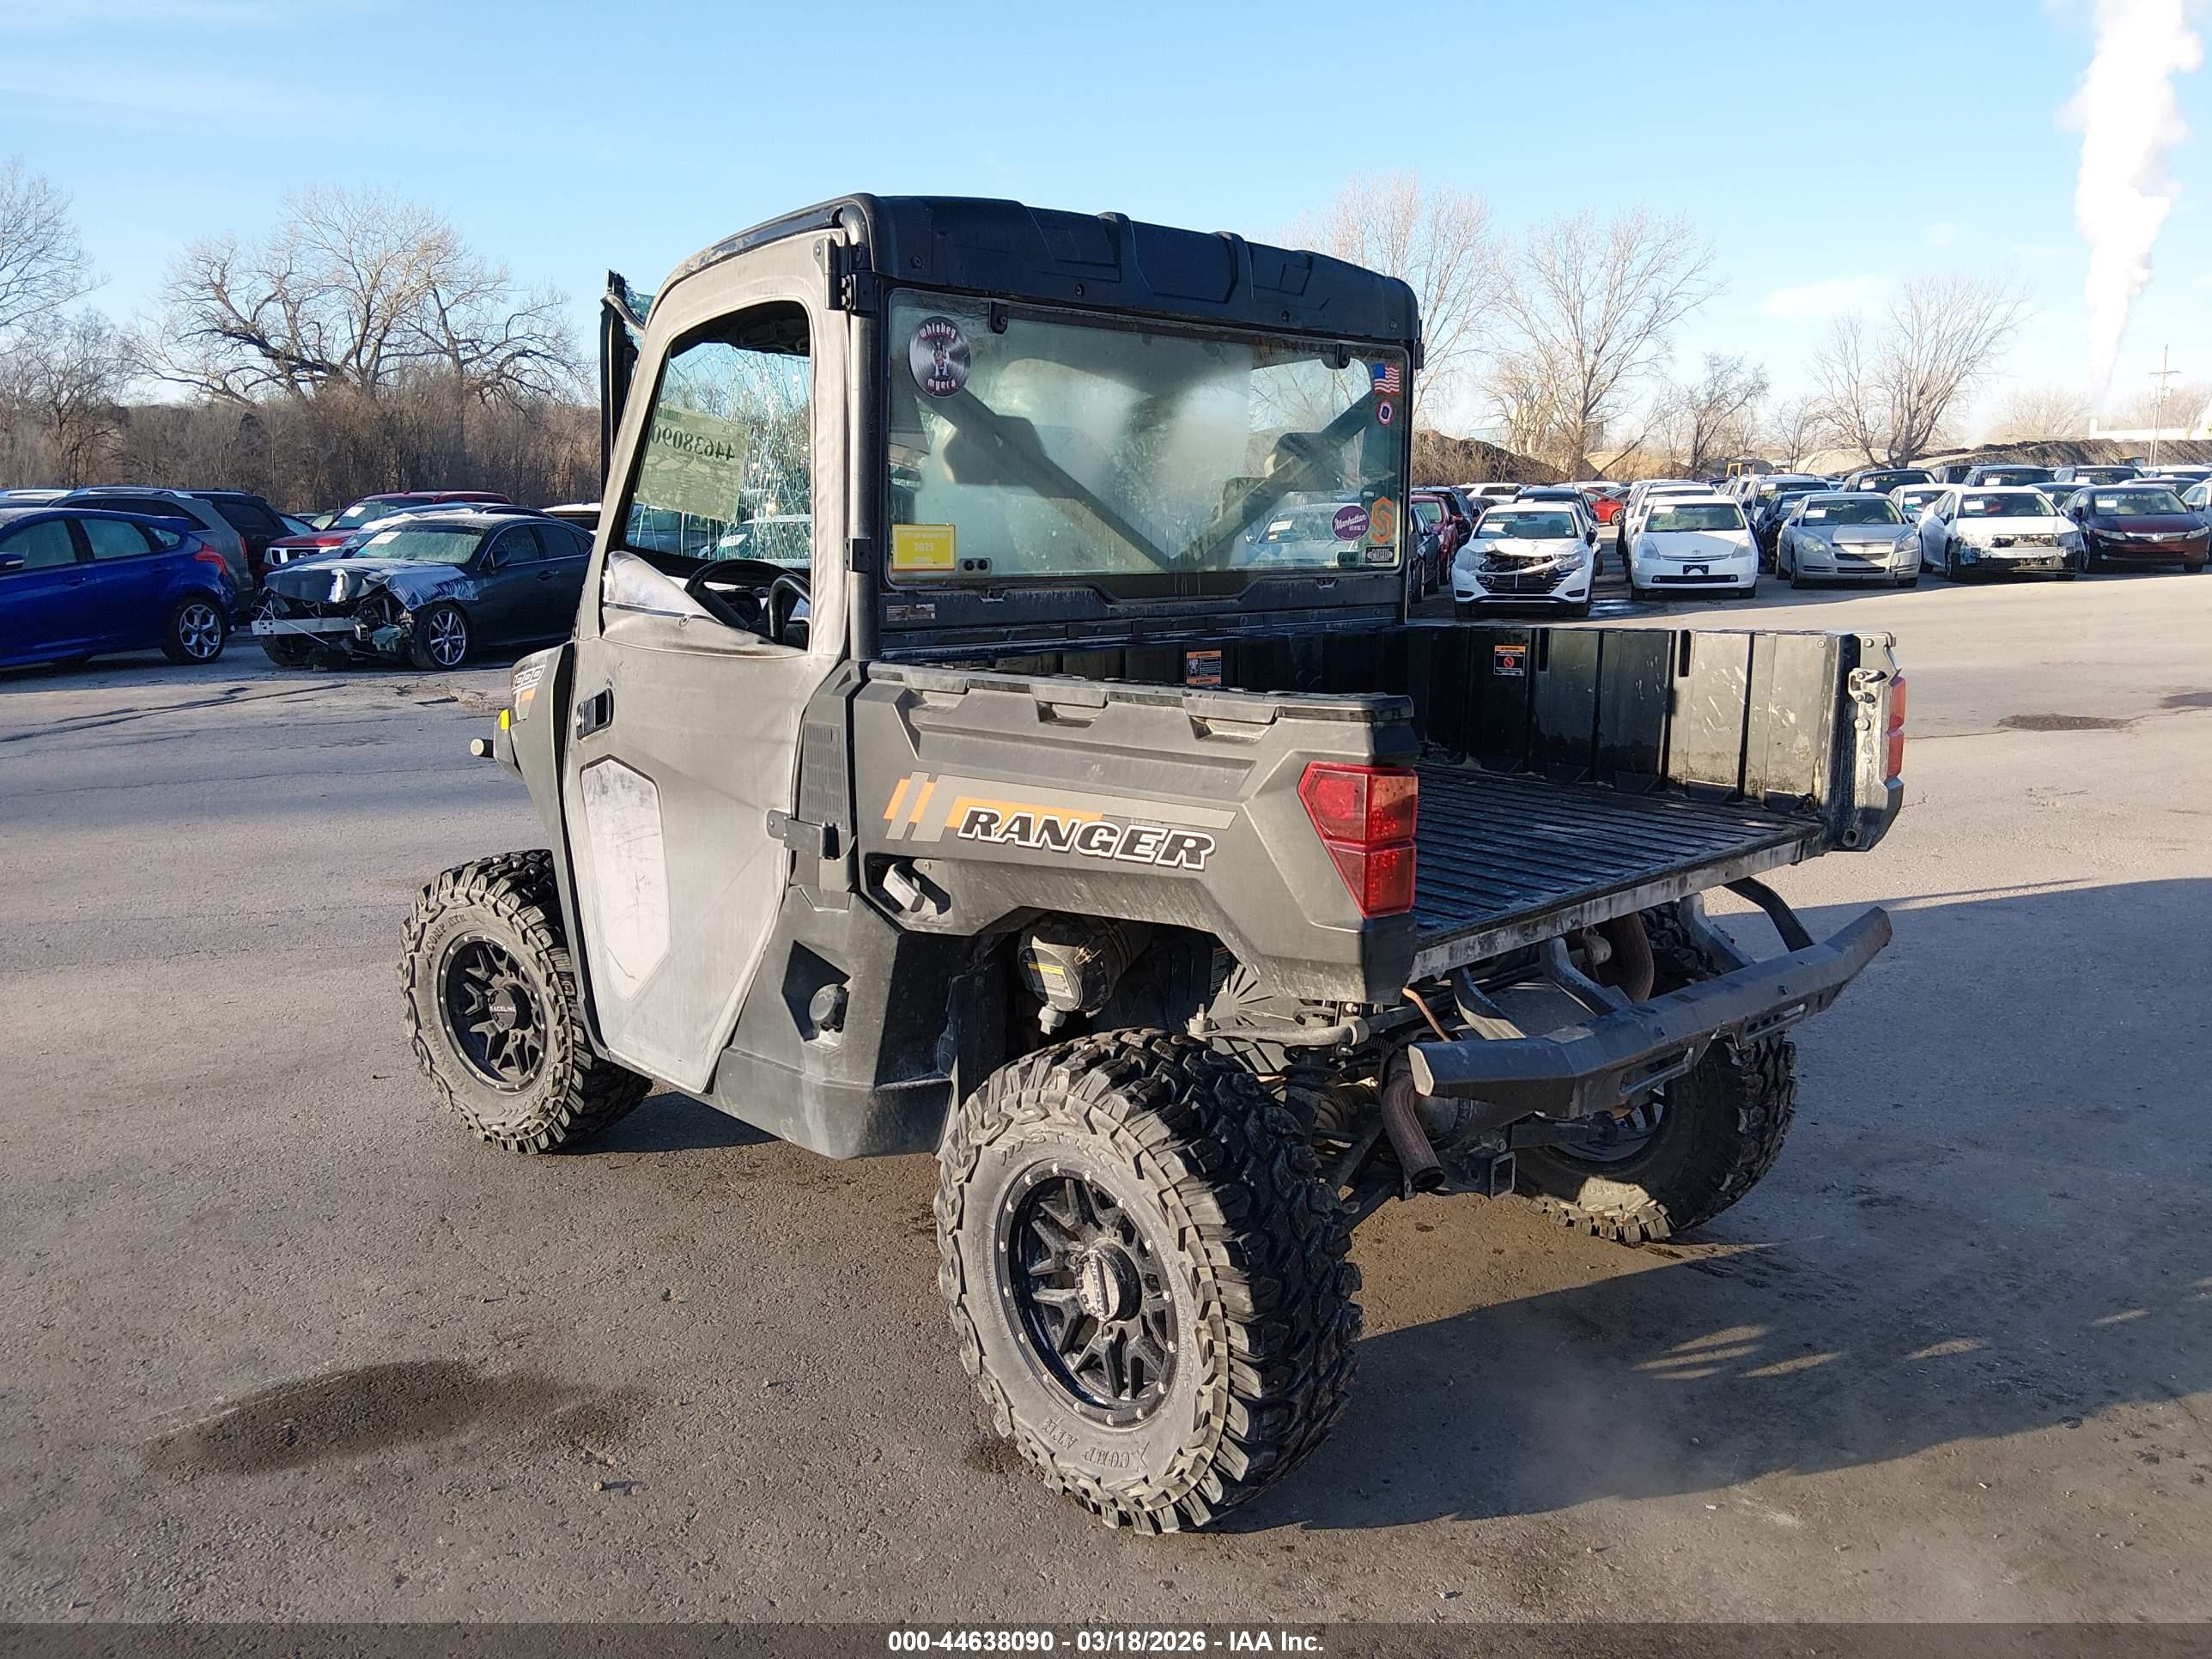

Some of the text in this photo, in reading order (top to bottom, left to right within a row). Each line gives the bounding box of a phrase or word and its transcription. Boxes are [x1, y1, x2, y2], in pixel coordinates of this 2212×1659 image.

[919, 322, 957, 339] whiskey
[927, 378, 956, 391] myers
[1334, 514, 1367, 531] Manhattan
[957, 807, 1216, 871] RANGER
